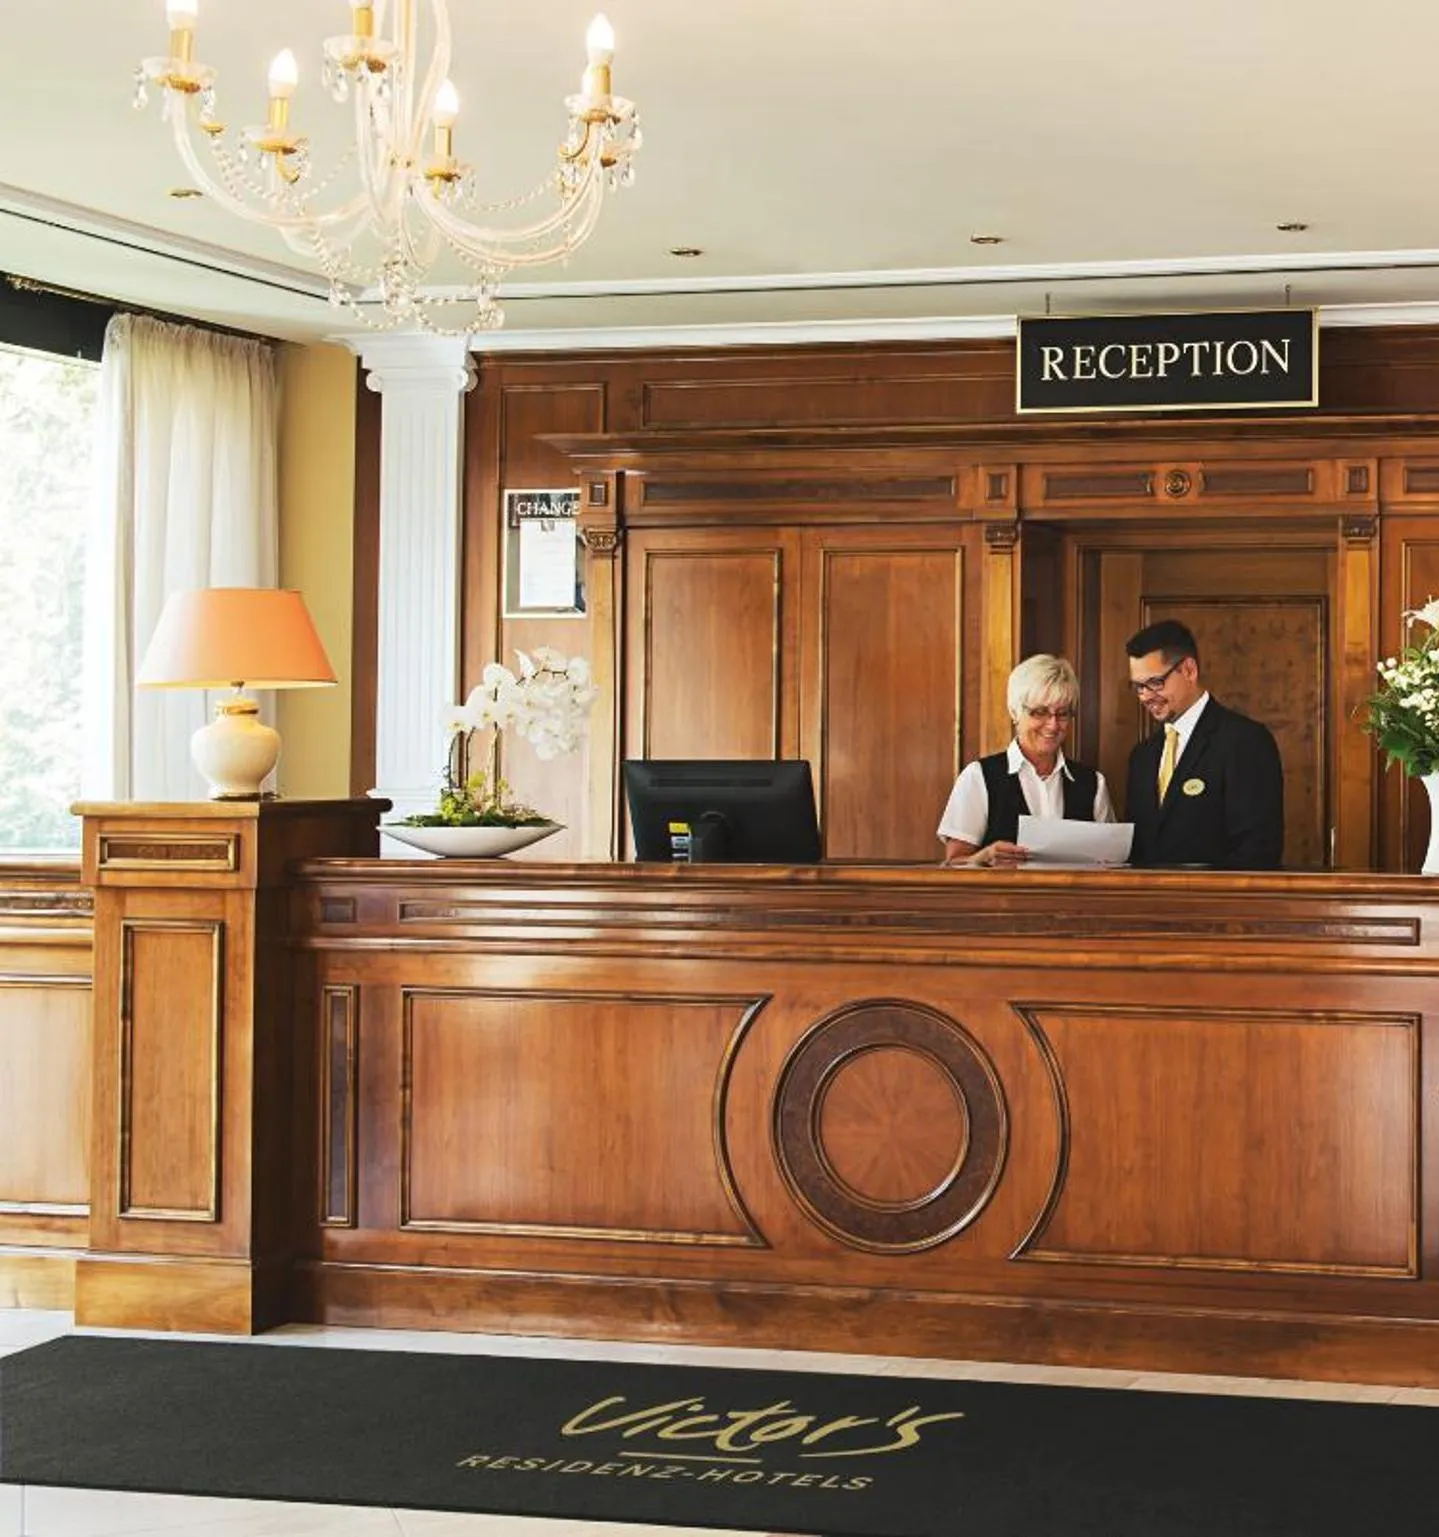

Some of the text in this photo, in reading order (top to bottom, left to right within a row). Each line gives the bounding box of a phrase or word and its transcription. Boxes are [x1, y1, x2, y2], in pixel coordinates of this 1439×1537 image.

[1040, 339, 1290, 381] RECEPTION
[517, 501, 581, 516] CHANGE
[562, 1397, 965, 1457] Victor's
[455, 1454, 874, 1490] RESIDENZ-HOTELS
